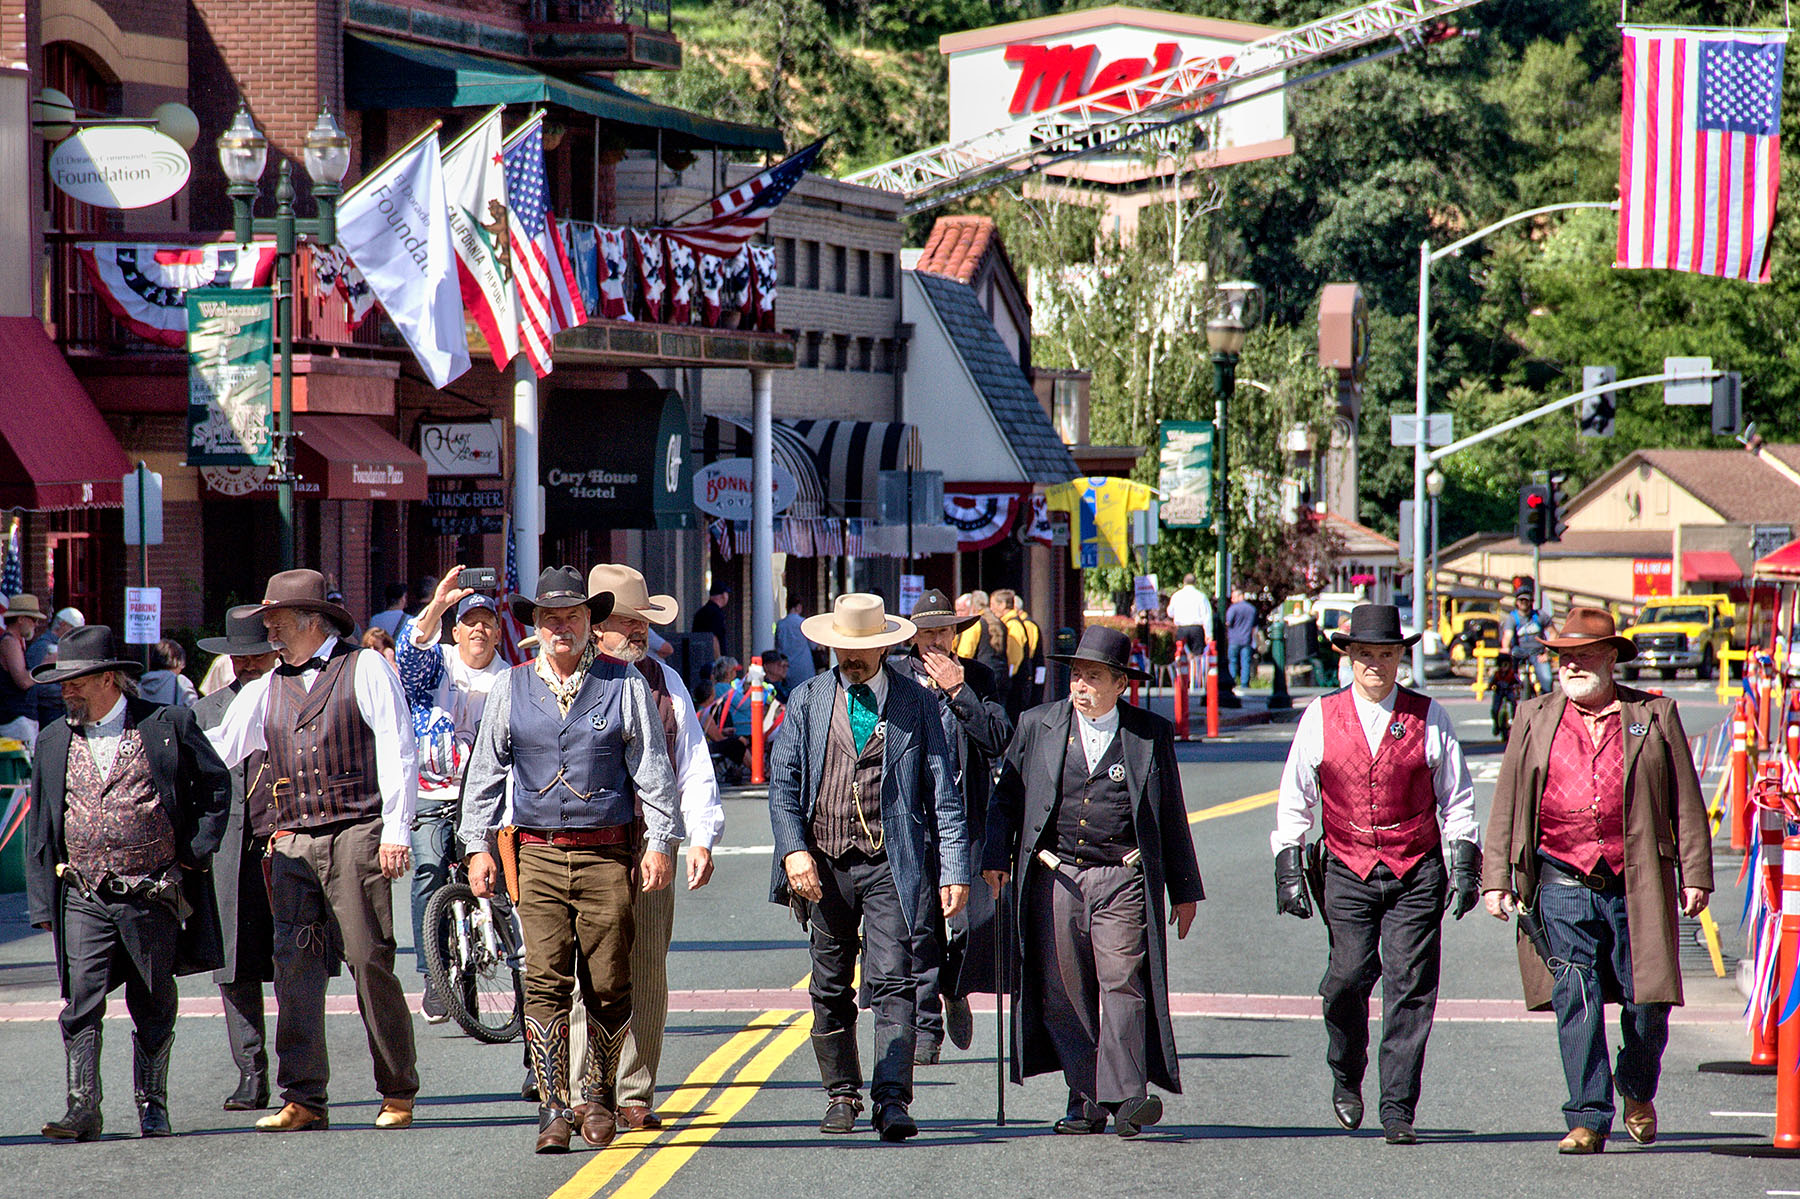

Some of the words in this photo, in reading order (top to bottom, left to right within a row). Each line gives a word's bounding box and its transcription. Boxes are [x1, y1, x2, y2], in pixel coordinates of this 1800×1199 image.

[56, 166, 151, 185] Foundation
[448, 205, 486, 267] CALIFORNIA
[192, 423, 270, 447] STREET
[548, 468, 586, 487] Cary
[588, 468, 638, 484] House
[441, 492, 472, 507] MUSIC
[569, 485, 616, 499] Hotel
[130, 603, 157, 613] PARKING
[129, 613, 156, 622] FRIDAY
